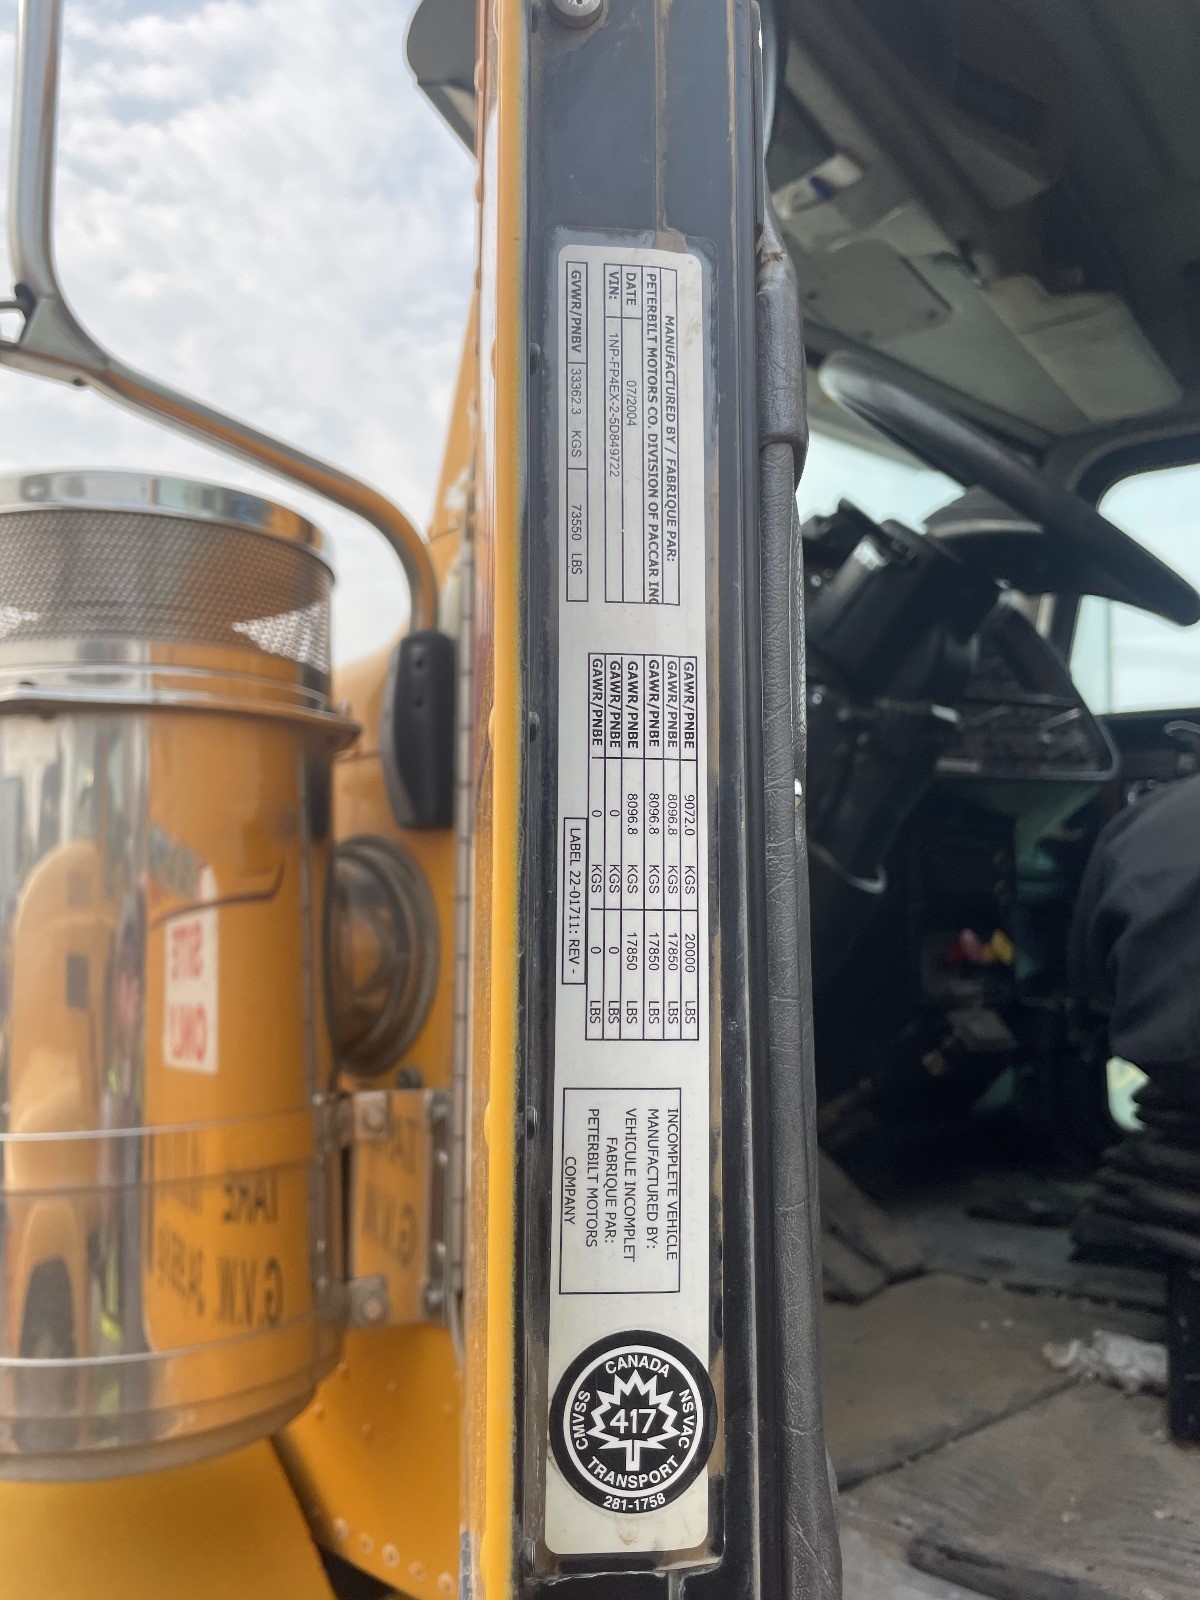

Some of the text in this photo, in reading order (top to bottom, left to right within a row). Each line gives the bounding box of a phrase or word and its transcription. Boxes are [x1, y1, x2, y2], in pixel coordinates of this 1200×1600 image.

[646, 273, 657, 343] PETERBILT
[608, 271, 619, 477] VIN: 1NP-FP4EX-2-5D849722
[626, 272, 637, 426] DATE 07/2004
[647, 347, 658, 403] MOTORS
[665, 316, 676, 422] MANUFACTURED
[569, 270, 582, 574] GVWR/PNBV 33362.3 KGS 73550 LBS
[647, 406, 658, 428] CO.
[666, 426, 676, 443] BY
[648, 434, 658, 498] DIVISION
[665, 459, 676, 526] FABRIQUE
[648, 502, 658, 521] OF
[648, 524, 658, 578] PACCAR
[666, 530, 676, 562] PAR:
[590, 658, 604, 746] GAWR/PNBE
[608, 660, 621, 748] GAWR/PNBE
[569, 828, 581, 866] LABEL
[625, 661, 638, 1024] GAWR/PNBE 8096.8 KGS 17850 LBS
[647, 659, 660, 1024] GAWR/PNBE 8096.8 KGS 17850 LBS
[665, 661, 679, 1024] GAWR/PNBE 8096.8 KGS 17850 LBS
[682, 662, 696, 1024] GAWR/PNBE 9072.0 KGS 20000 LBS
[569, 871, 581, 934] 22-01711:
[591, 864, 602, 894] KGS
[609, 864, 620, 894] KGS
[568, 939, 580, 965] REV
[590, 1000, 601, 1024] LBS
[608, 1000, 619, 1024] LBS
[564, 1156, 576, 1225] COMPANY
[586, 1108, 599, 1247] PETERBILT MOTORS
[604, 1137, 618, 1243] FABRIQUE PAR:
[624, 1108, 637, 1262] VEHICULE INCOMPLET
[646, 1108, 658, 1249] MANUFACTURED BY:
[666, 1108, 678, 1260] INCOMPLETE VEHICLE
[605, 1355, 670, 1378] CANADA
[572, 1390, 591, 1450] CMVSS
[610, 1408, 657, 1434] 417
[587, 1455, 679, 1488] TRANSPORT
[602, 1492, 666, 1511] 281-1758
